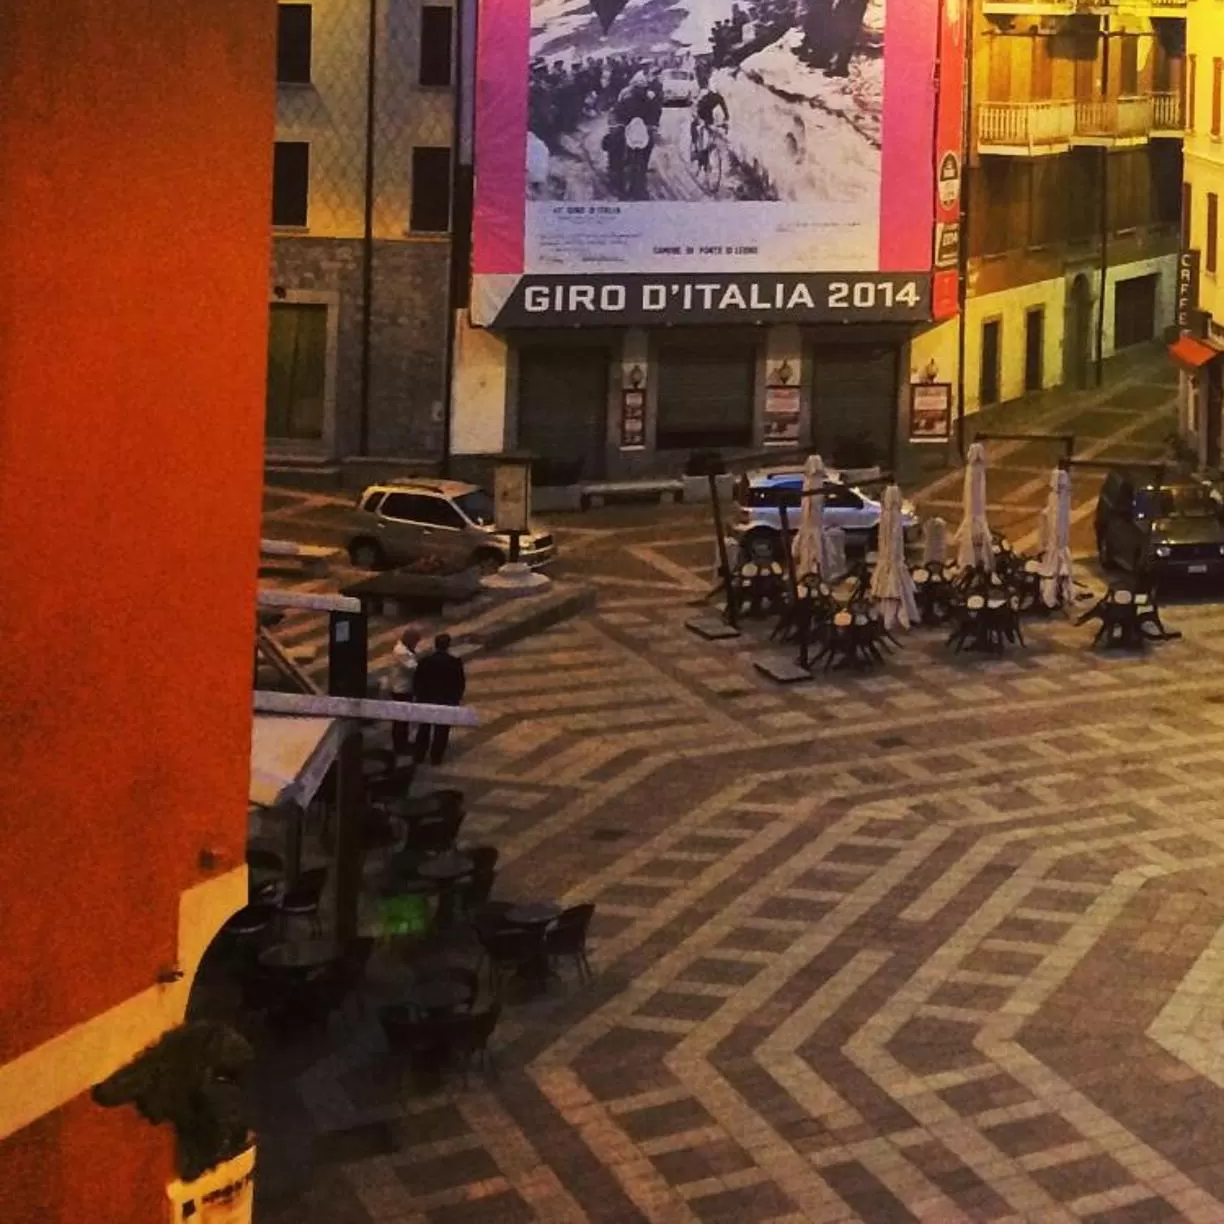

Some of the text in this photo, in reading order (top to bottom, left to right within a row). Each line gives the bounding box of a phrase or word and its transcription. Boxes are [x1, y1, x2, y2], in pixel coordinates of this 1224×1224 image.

[524, 281, 921, 312] GIRO D'ITALIA 2014
